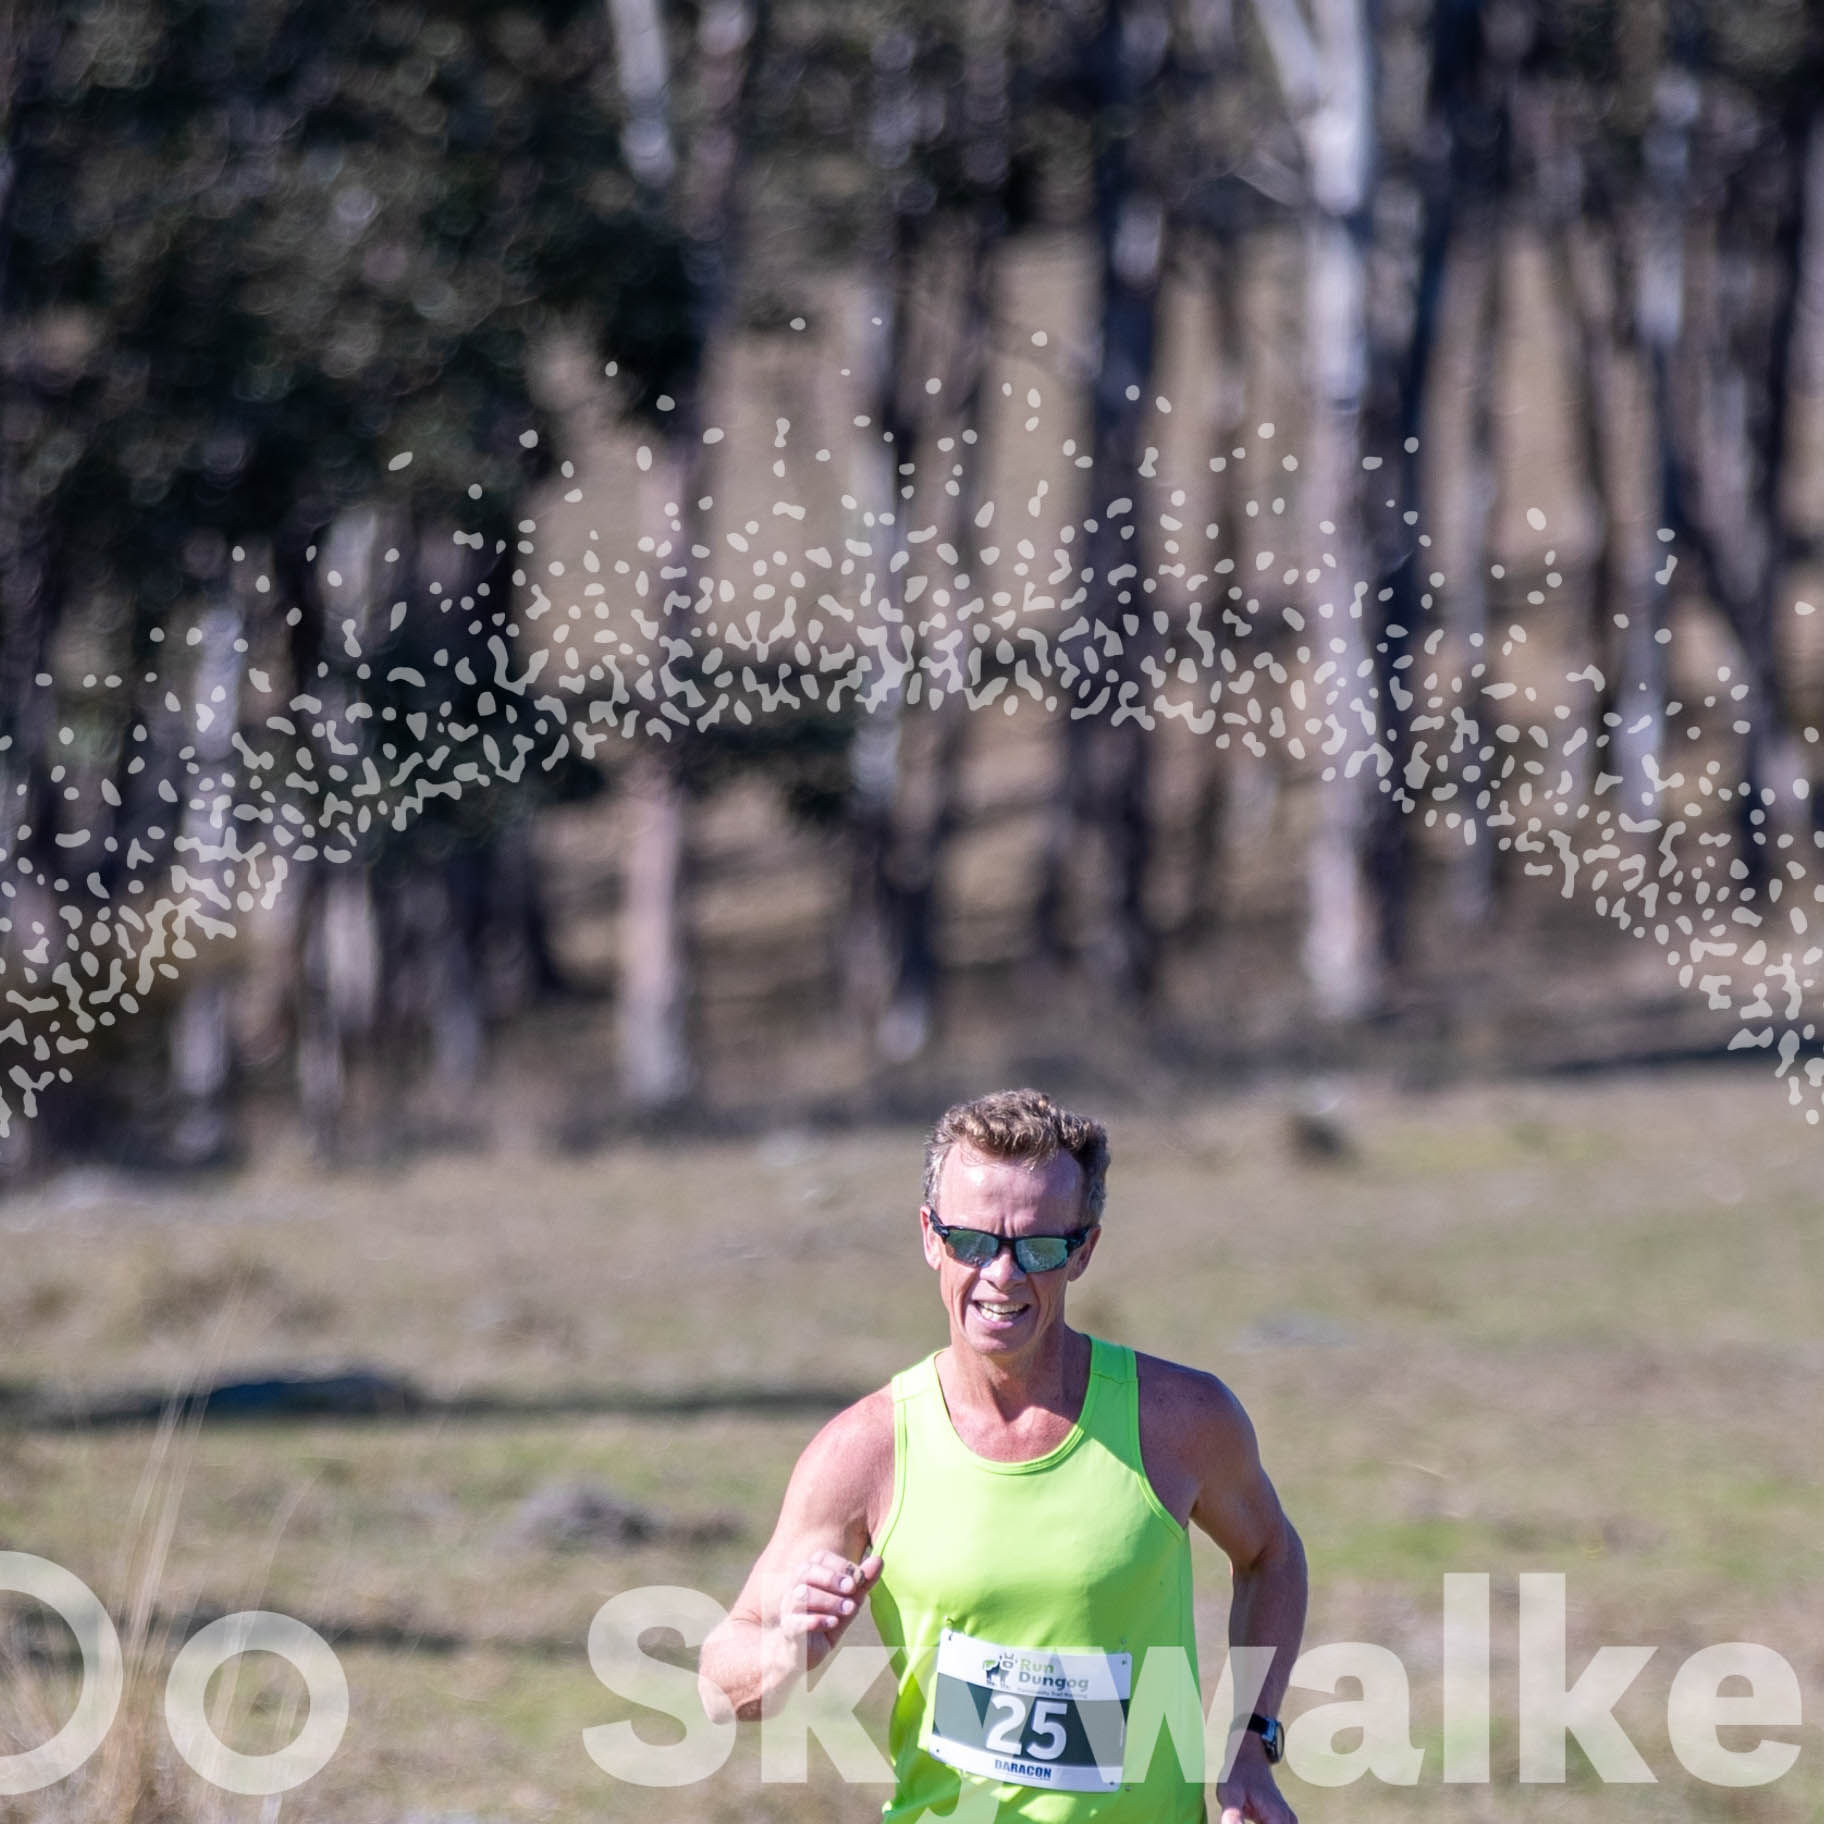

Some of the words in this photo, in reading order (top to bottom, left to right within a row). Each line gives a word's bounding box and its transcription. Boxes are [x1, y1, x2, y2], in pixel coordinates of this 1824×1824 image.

[1020, 1659, 1054, 1673] Run
[1019, 1672, 1088, 1692] Dungog
[985, 1694, 1068, 1761] 25
[994, 1759, 1052, 1778] DARACON
